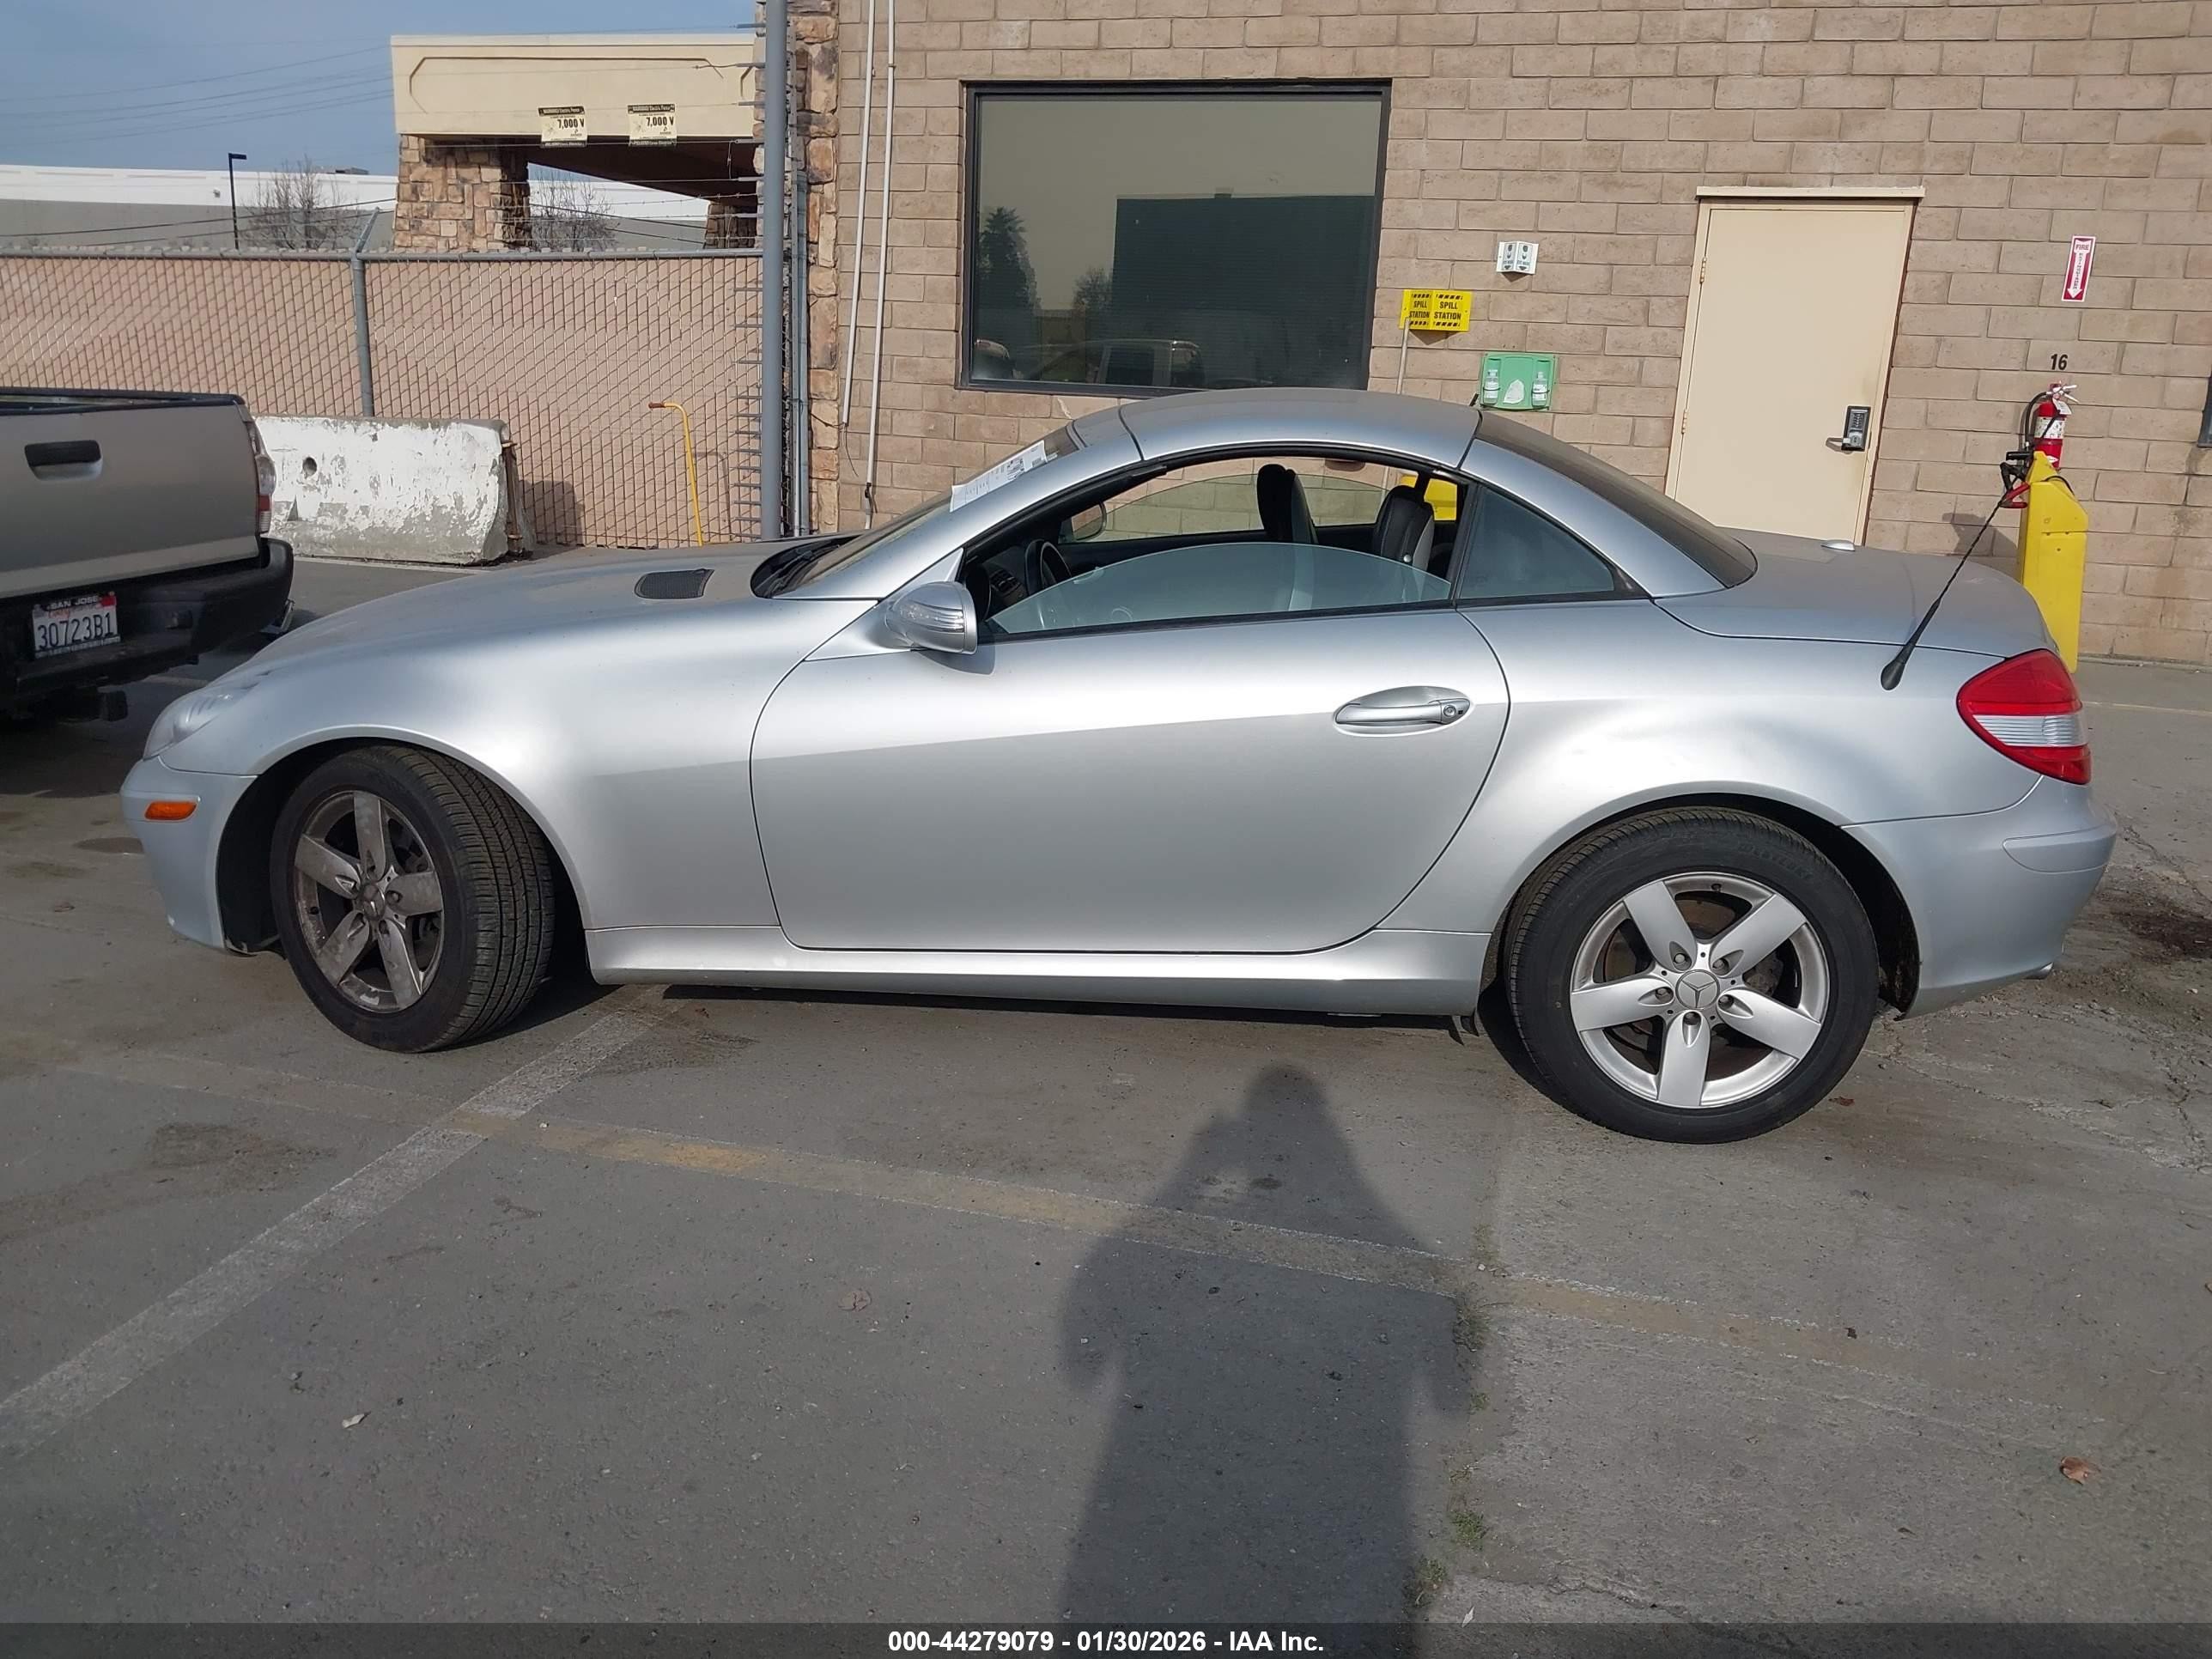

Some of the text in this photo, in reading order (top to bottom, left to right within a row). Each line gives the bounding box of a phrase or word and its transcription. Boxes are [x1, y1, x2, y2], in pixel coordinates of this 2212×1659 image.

[556, 118, 585, 130] 7,000 V
[646, 116, 674, 128] 7,000 V
[1434, 311, 1462, 320] STATION
[2051, 353, 2069, 370] 16
[51, 600, 71, 610] SAN
[75, 595, 99, 605] JOSE
[38, 612, 113, 650] 30723B1
